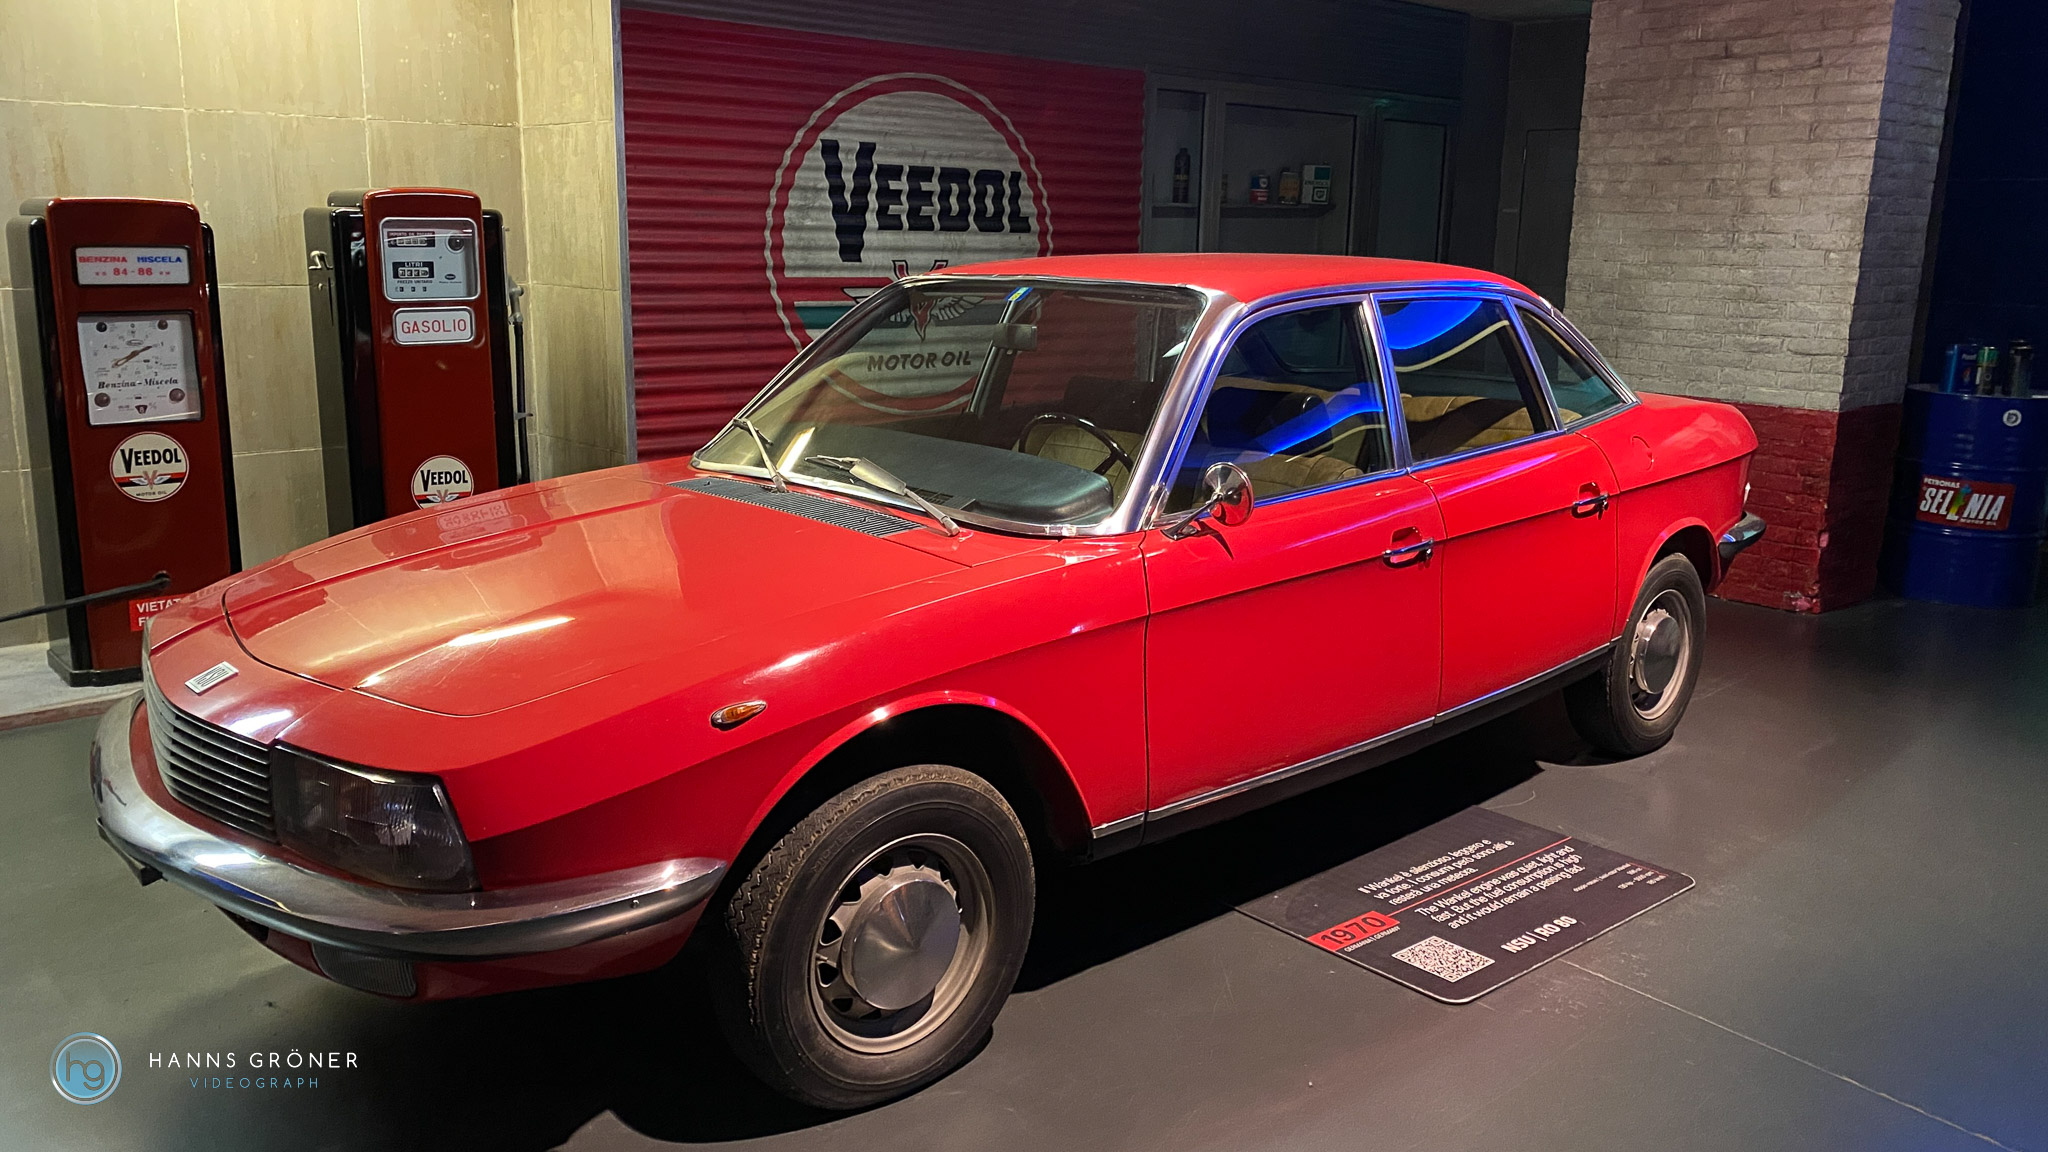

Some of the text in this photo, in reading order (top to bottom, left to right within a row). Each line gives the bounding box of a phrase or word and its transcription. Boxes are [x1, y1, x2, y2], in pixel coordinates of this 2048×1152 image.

[820, 139, 1031, 262] VEEDOL
[401, 318, 467, 334] GASOLIO
[867, 350, 972, 372] MOTOR OIL
[120, 448, 181, 474] VEEDOL
[420, 469, 468, 492] VEEDOL
[1923, 478, 1961, 489] PETRONAS
[1364, 871, 1402, 891] Wankel
[1409, 856, 1455, 875] silenzioso,
[1448, 842, 1484, 859] leggero
[1374, 891, 1391, 900] va
[1384, 882, 1415, 895] forte.
[1415, 864, 1455, 883] consumi
[1472, 848, 1495, 860] sono
[1414, 845, 1575, 917] The Wankel engine was quiet, light and
[1420, 882, 1441, 893] una
[1437, 866, 1479, 886] meteora.
[1430, 911, 1456, 923] fast.
[1450, 902, 1474, 914] But
[1468, 896, 1489, 906] the
[1483, 887, 1506, 899] fuel
[1503, 865, 1558, 892] consumption
[1558, 854, 1582, 866] high
[1448, 916, 1469, 929] and
[1463, 913, 1477, 921] it
[1473, 900, 1504, 917] would
[1501, 888, 1534, 905] remain
[1536, 871, 1572, 890] passing
[1321, 916, 1386, 944] 1970
[1500, 934, 1537, 954] NSU
[1533, 923, 1561, 938] RO
[1553, 915, 1578, 928] 80
